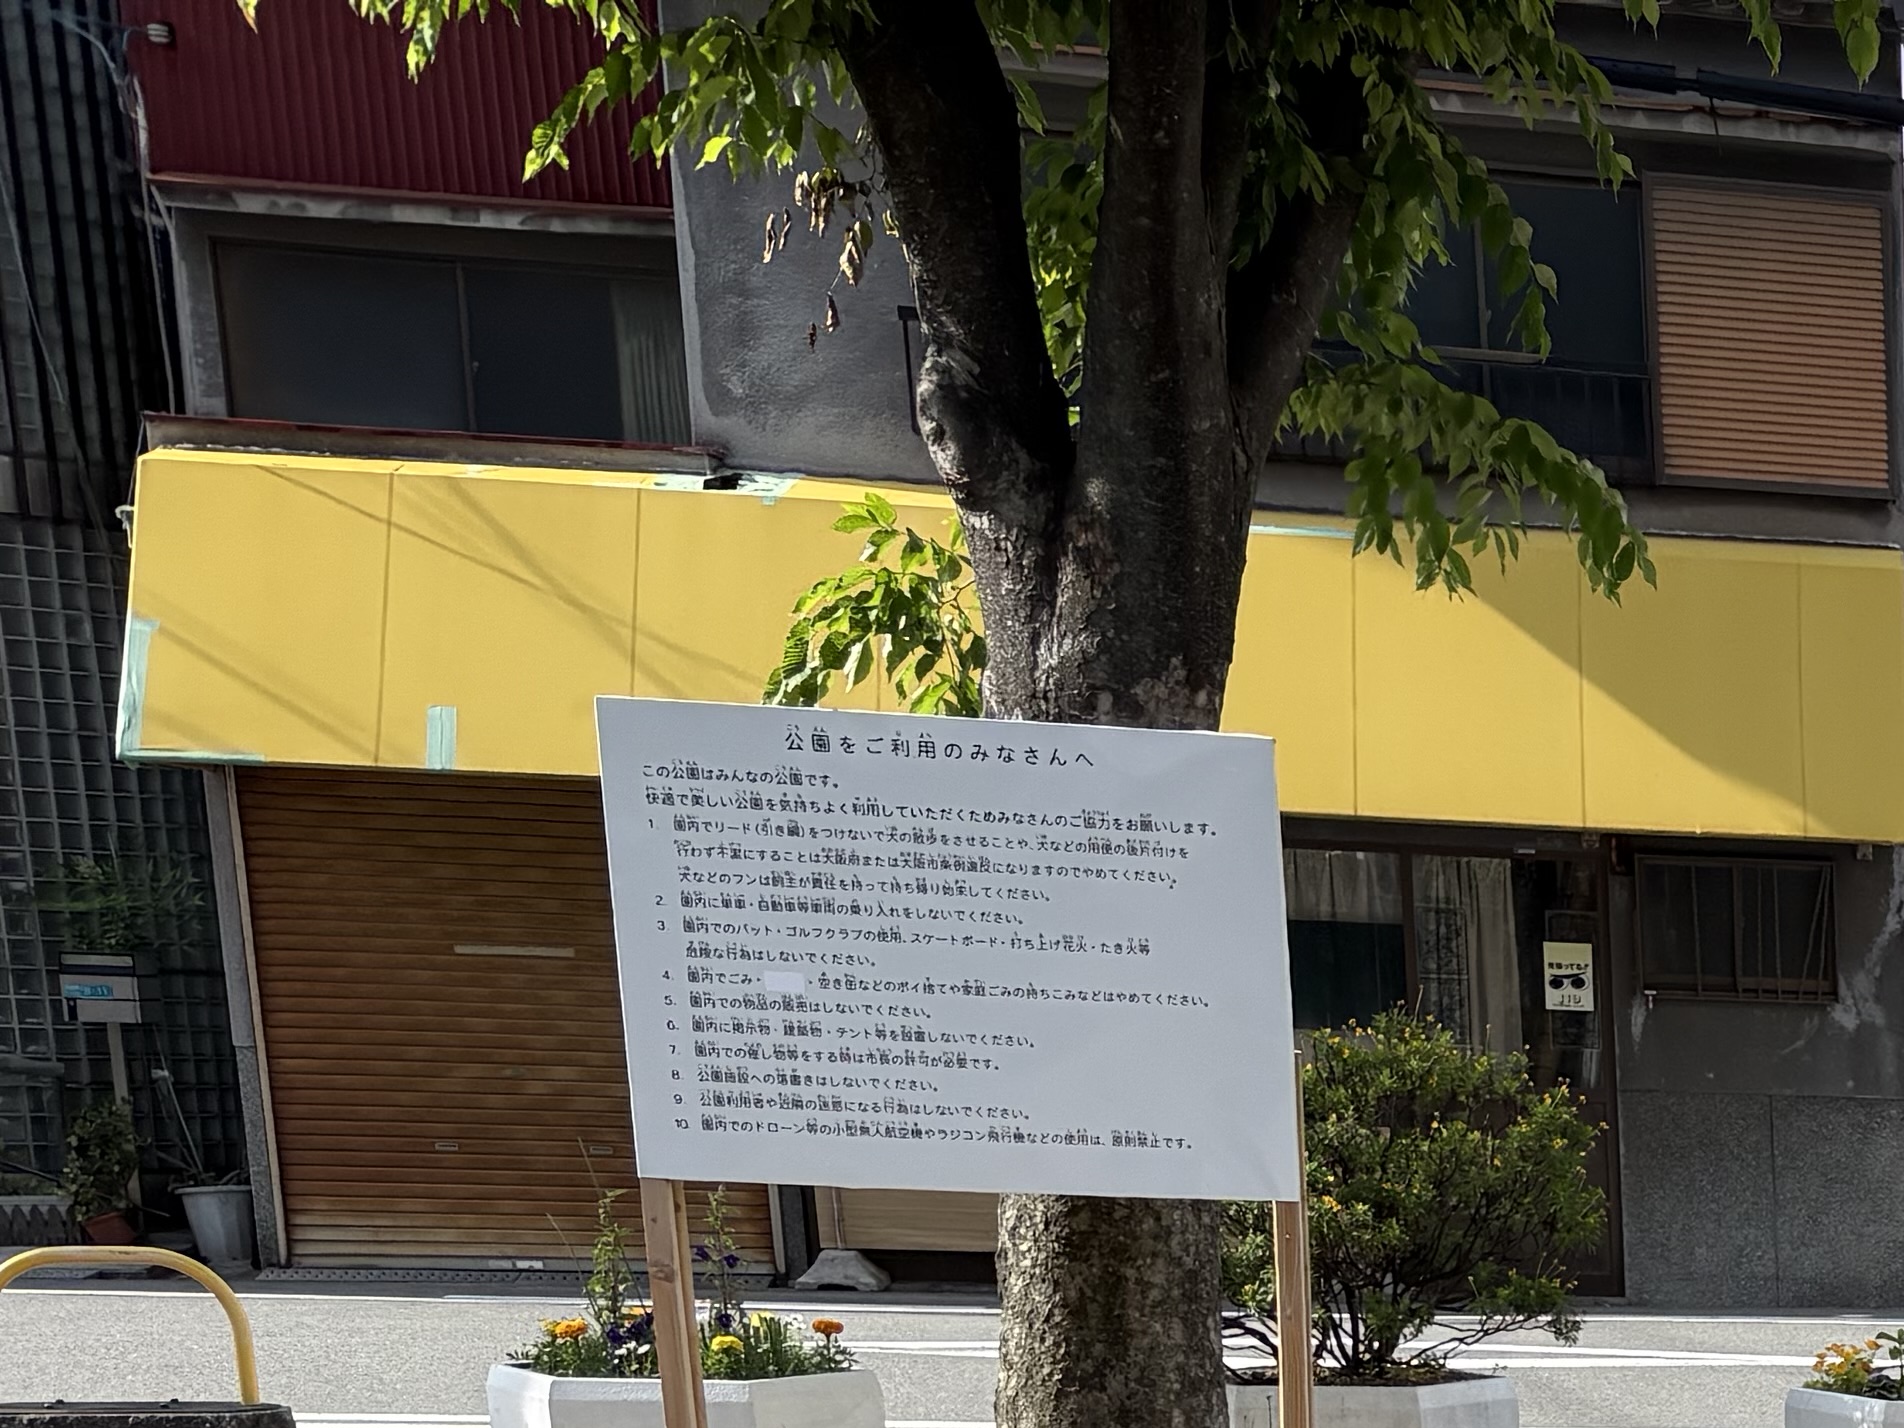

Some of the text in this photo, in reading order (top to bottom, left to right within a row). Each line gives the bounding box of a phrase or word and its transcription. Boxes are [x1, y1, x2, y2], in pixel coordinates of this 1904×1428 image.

[784, 730, 1094, 767] 公園をご利用のみなさんへ
[642, 764, 839, 789] この公園はみんなの公園です。
